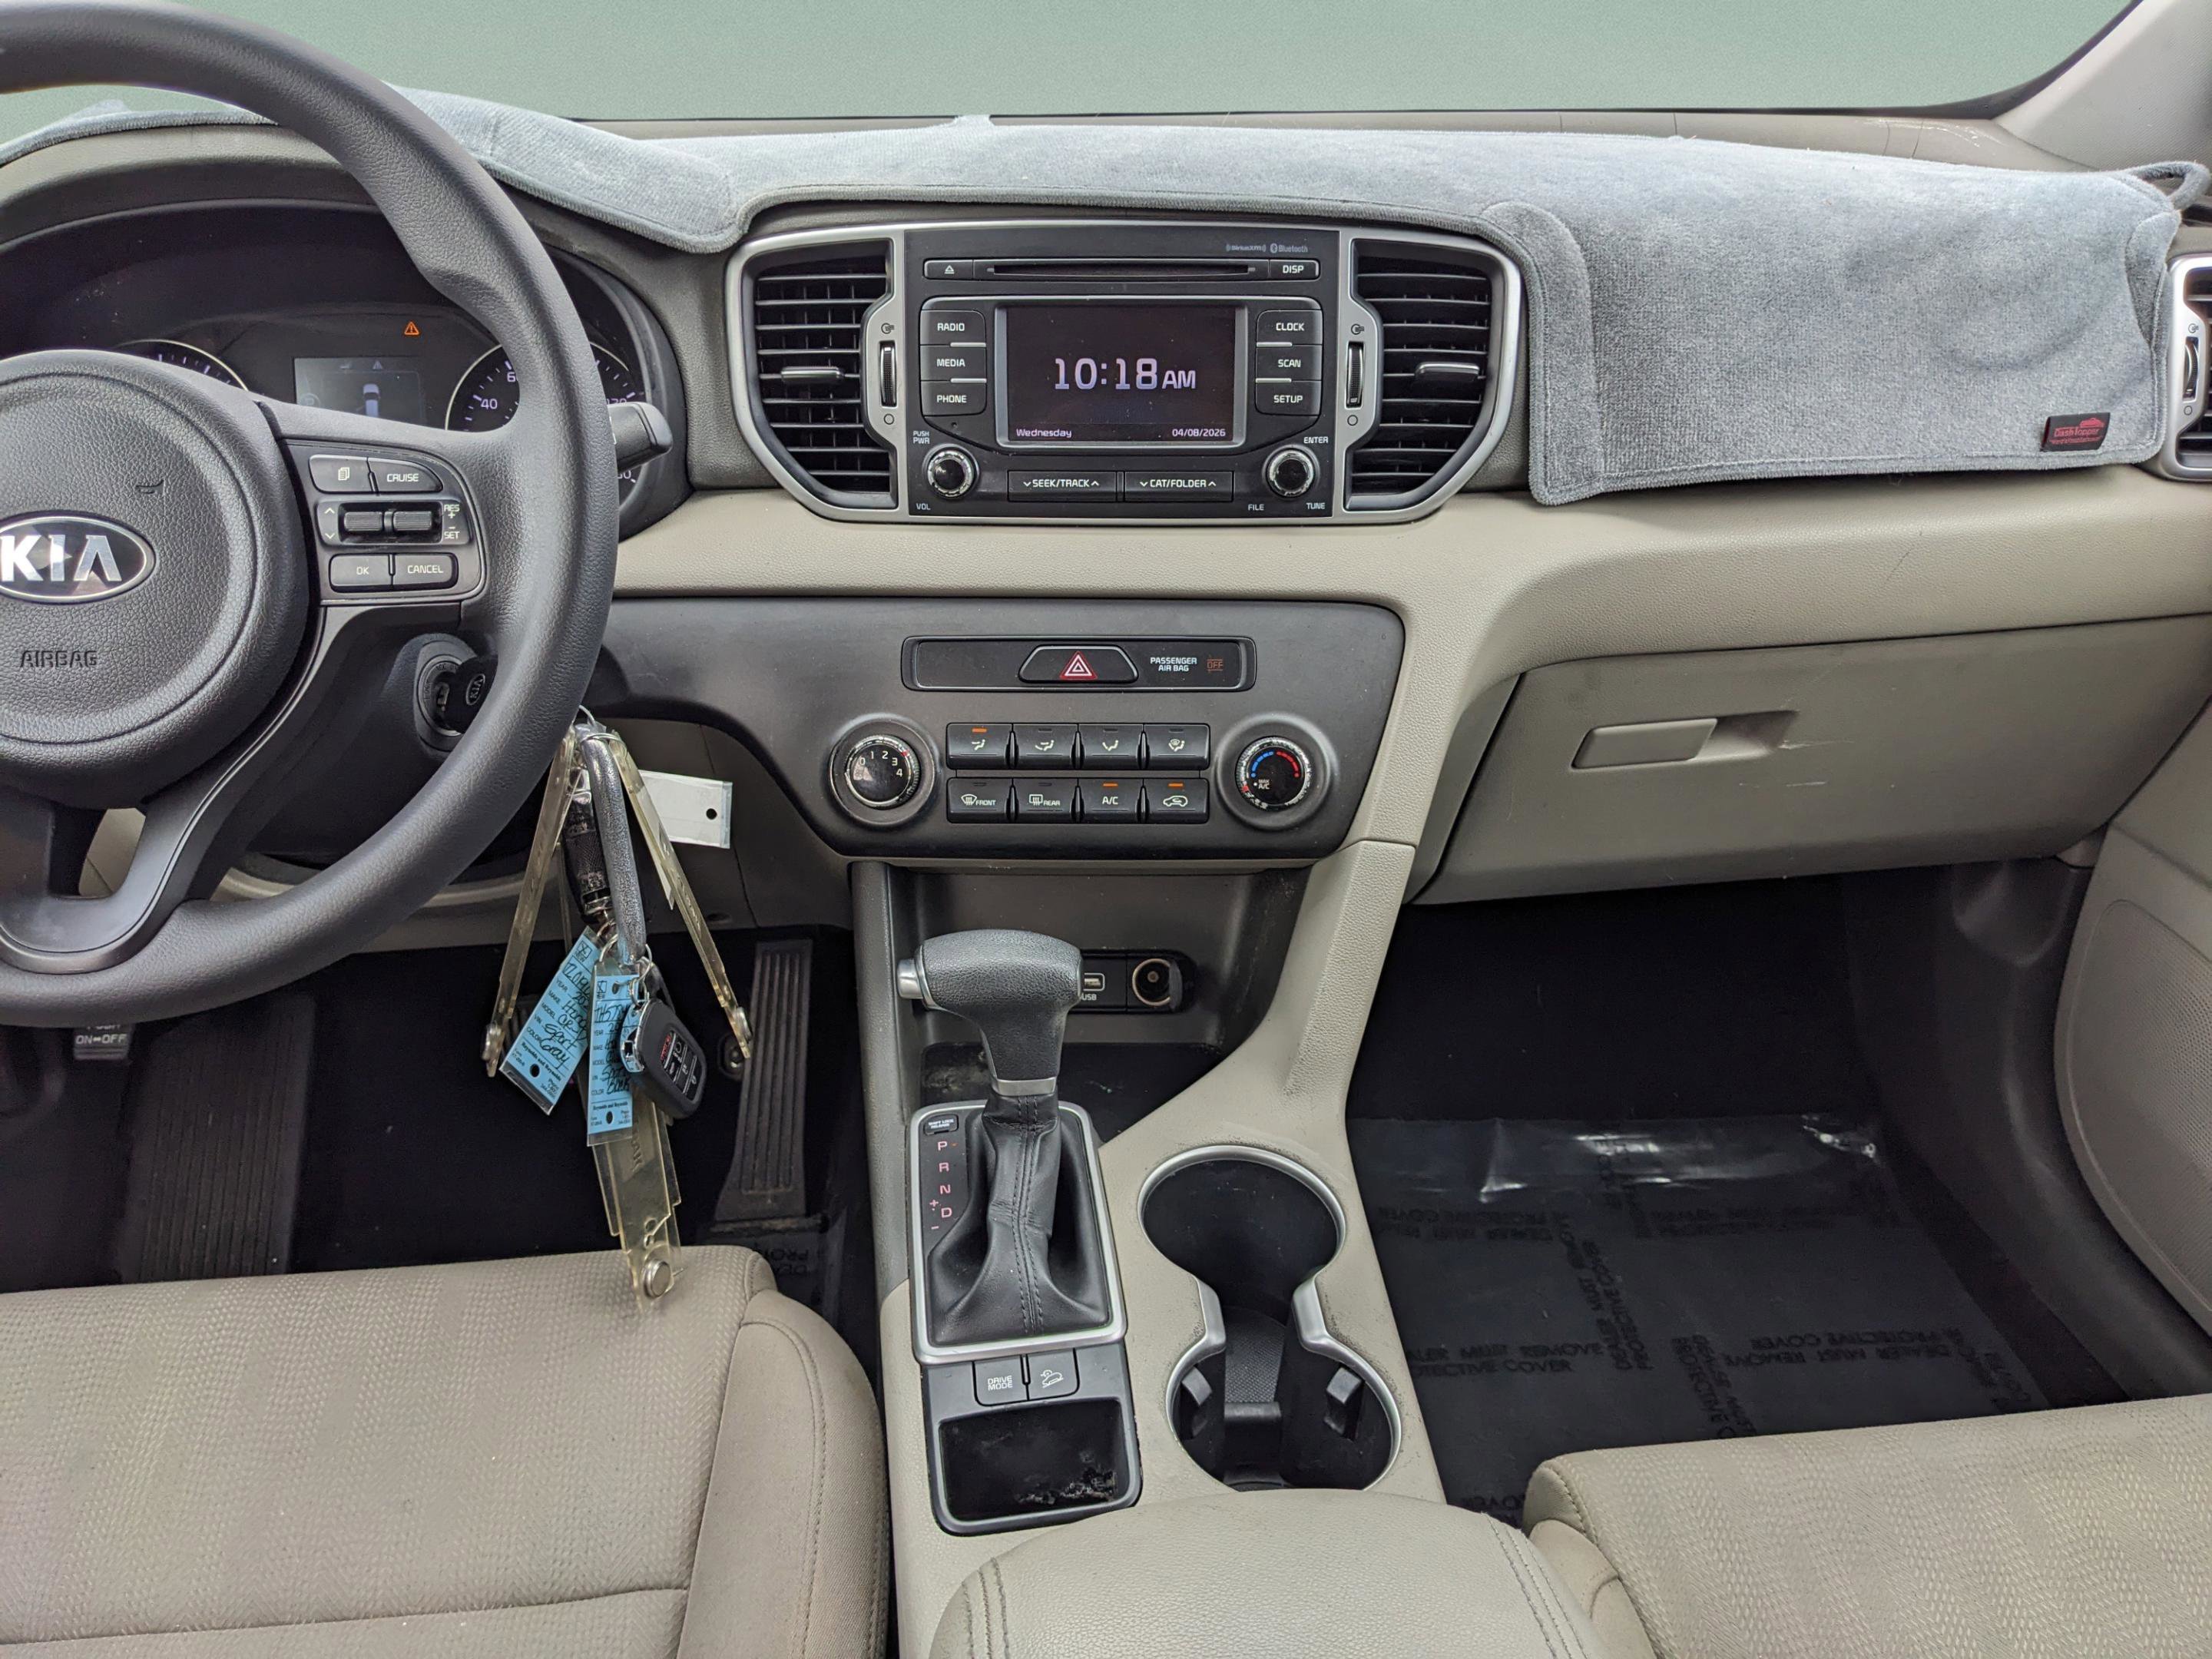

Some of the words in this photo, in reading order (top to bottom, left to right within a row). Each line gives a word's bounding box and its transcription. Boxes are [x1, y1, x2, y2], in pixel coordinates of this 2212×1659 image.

[1278, 244, 1308, 253] Bluetooth
[1282, 265, 1304, 273] DISP
[937, 323, 965, 331] RADIO
[1276, 323, 1305, 331] CLOCK
[936, 359, 965, 367] MEDIA
[1277, 359, 1301, 368] SCAN
[1055, 358, 1157, 390] 10:18
[1162, 369, 1197, 389] AM
[481, 398, 498, 409] 40
[936, 395, 967, 403] PHONE
[1273, 395, 1303, 404] SETUP
[1015, 428, 1072, 439] Wednesday
[1171, 428, 1227, 438] 04/08/2026
[1303, 436, 1329, 445] ENTER
[386, 473, 419, 482] CRUISE
[1031, 478, 1091, 488] SEEK/TRACK
[1149, 478, 1207, 488] CAT/FOLDER
[443, 504, 460, 512] RES
[443, 531, 460, 539] SET
[0, 534, 122, 582] KIA
[356, 566, 369, 575] OK
[407, 565, 444, 575] CANCEL
[20, 650, 98, 669] AIRBAG
[1150, 657, 1197, 665] PASSENGER
[1207, 660, 1224, 671] OFF
[870, 750, 874, 760] 1
[882, 750, 889, 760] 2
[859, 757, 866, 766] 0
[892, 757, 898, 767] 3
[896, 768, 903, 777] 4
[1101, 795, 1119, 806] A/C
[555, 979, 568, 992] YEAR
[548, 991, 561, 1005] MAKE
[539, 1002, 557, 1018] MODEL
[76, 1035, 92, 1045] ON
[101, 1033, 127, 1044] OFF
[525, 1026, 542, 1043] COLOR
[520, 1041, 538, 1060] Reynolds
[543, 1064, 562, 1082] Reynolds
[937, 1141, 948, 1151] P
[939, 1162, 949, 1172] R
[939, 1184, 951, 1194] N
[941, 1207, 952, 1218] D
[1505, 1358, 1573, 1374] COVER
[987, 1375, 1013, 1384] DRIVE
[987, 1381, 1013, 1391] MODE
